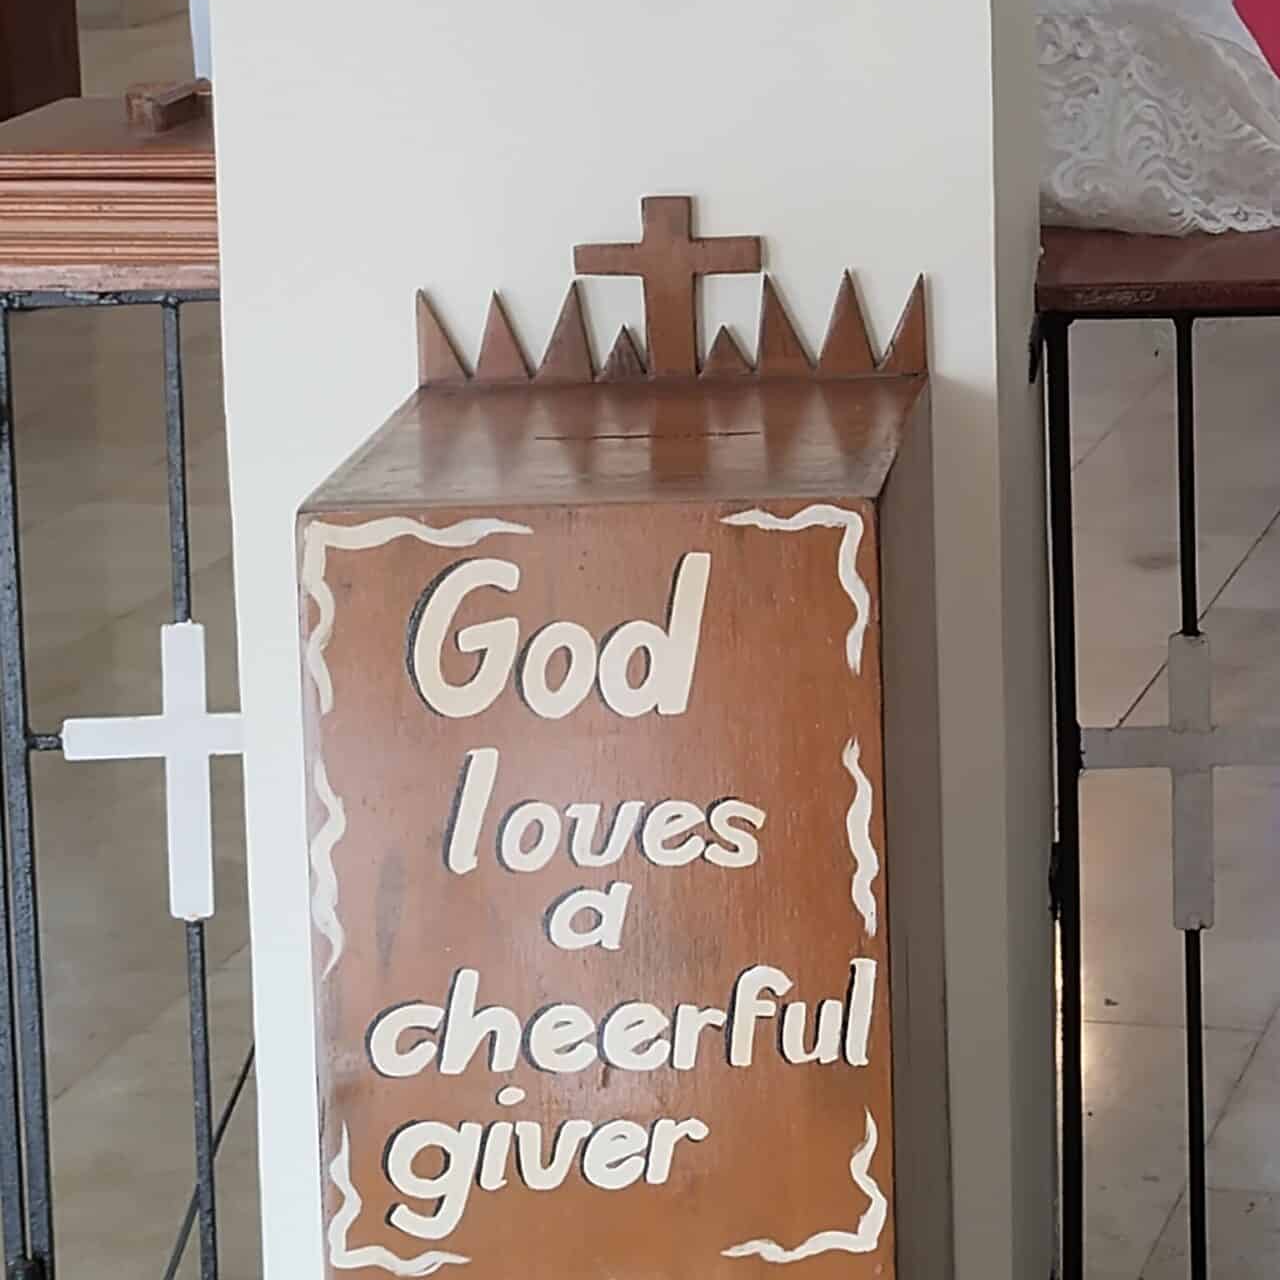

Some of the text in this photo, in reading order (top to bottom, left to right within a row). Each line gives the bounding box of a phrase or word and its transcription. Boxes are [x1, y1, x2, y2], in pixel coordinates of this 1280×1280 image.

[408, 553, 711, 718] God
[444, 748, 766, 874] loves
[545, 881, 632, 951] a
[366, 958, 877, 1077] cheerful
[385, 1086, 708, 1240] giver
